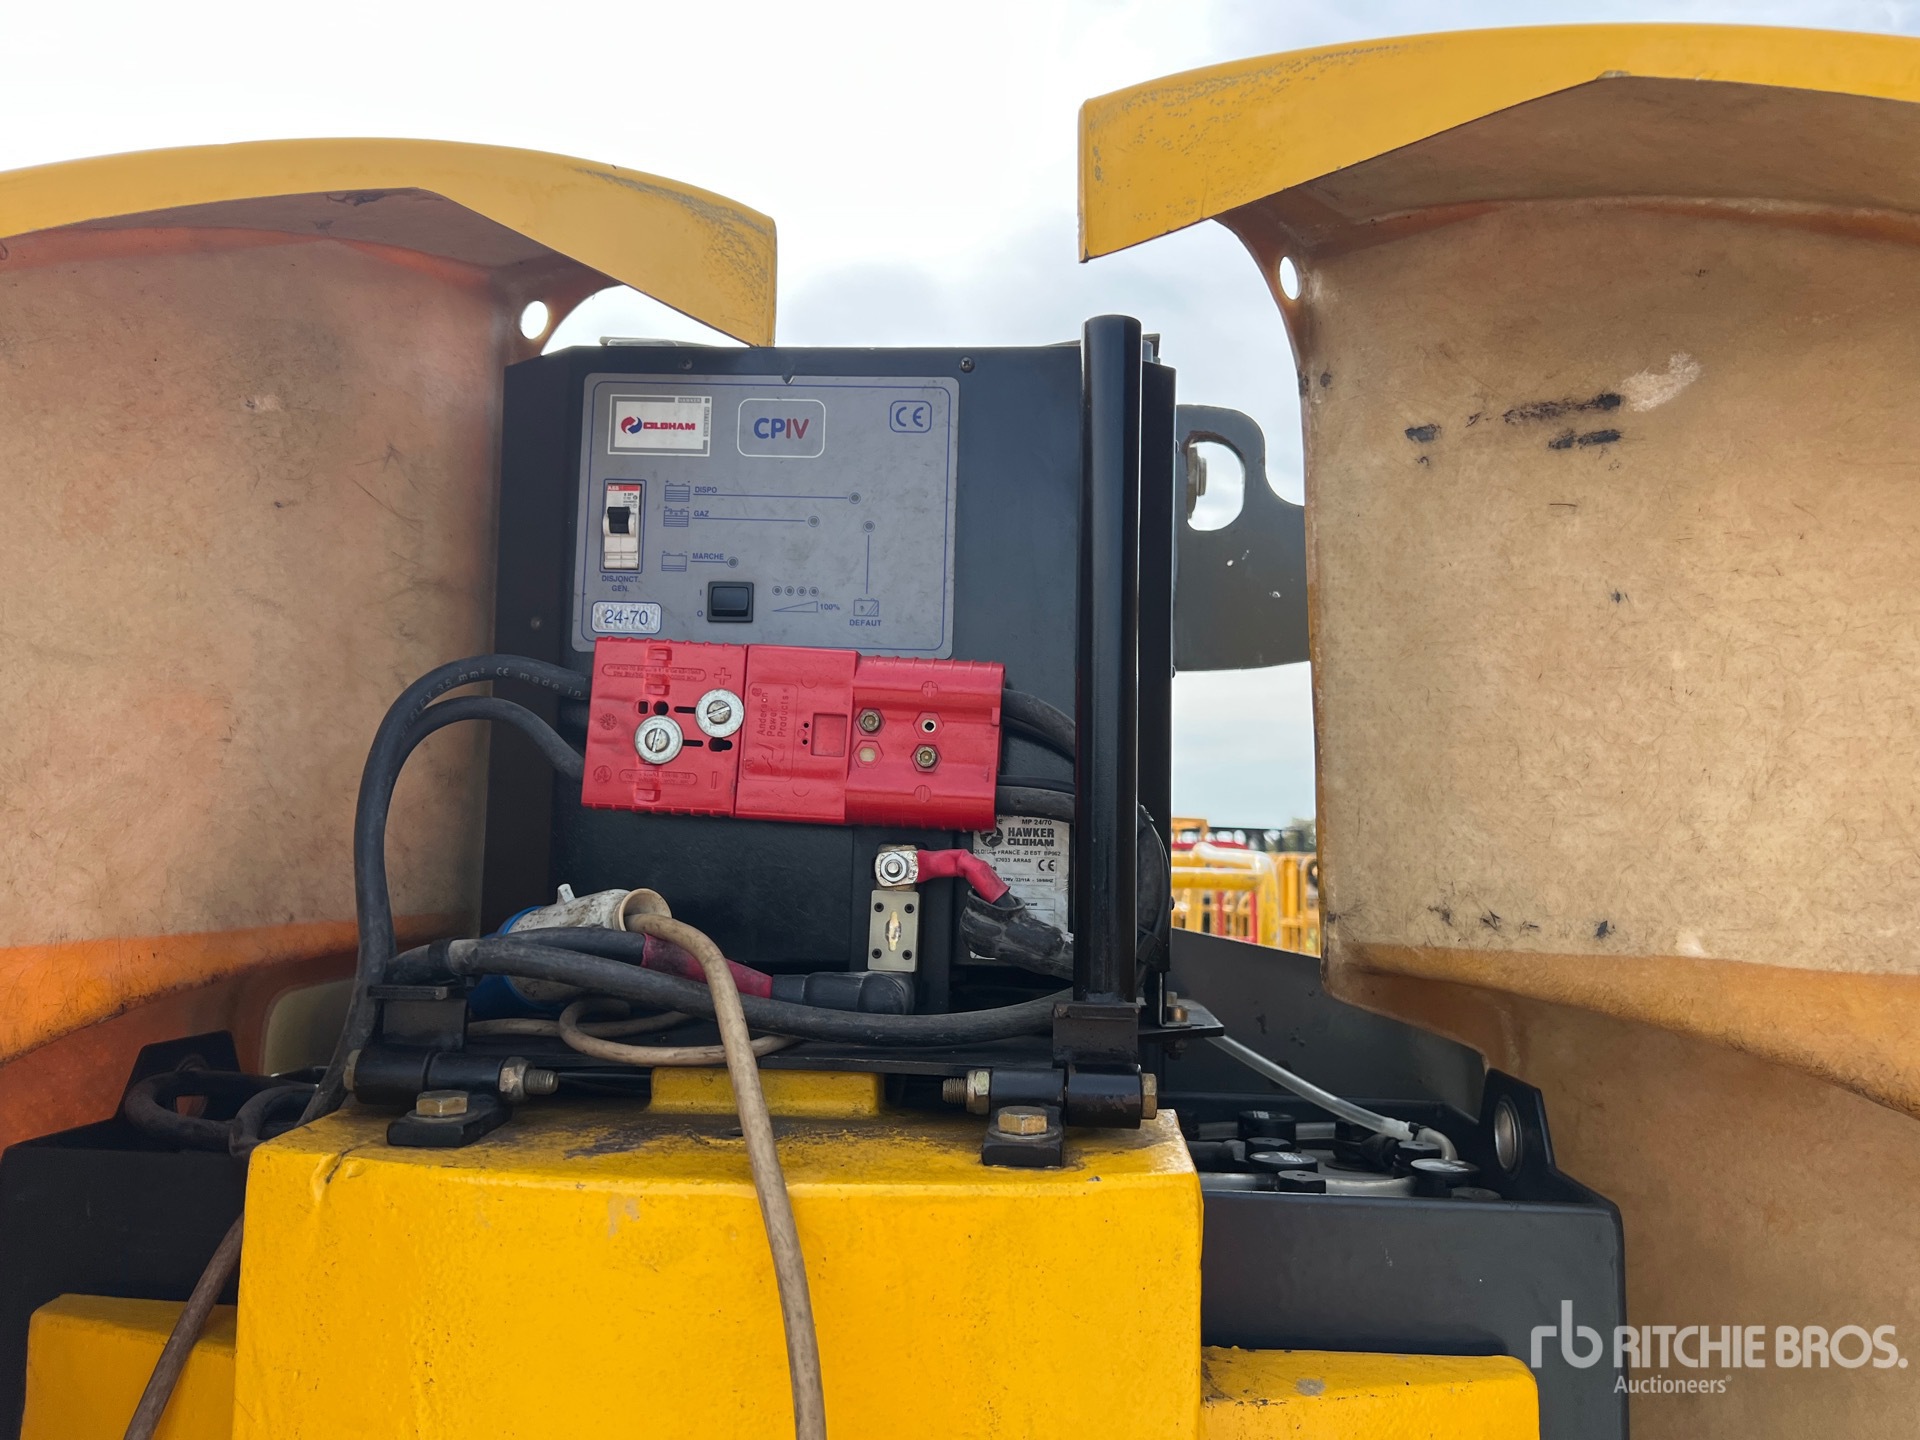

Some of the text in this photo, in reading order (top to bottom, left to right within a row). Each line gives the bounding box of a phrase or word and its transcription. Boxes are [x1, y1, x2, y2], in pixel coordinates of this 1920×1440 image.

[643, 421, 696, 431] OLDHAM
[753, 417, 810, 440] CPIV
[694, 486, 718, 494] DISPO
[693, 510, 710, 518] GAZ
[692, 552, 725, 560] MARCHE
[820, 603, 841, 611] 100%
[604, 608, 649, 626] 24-70
[849, 619, 882, 627] DEFAUT
[756, 692, 769, 736] Anderson
[776, 695, 790, 738] Products
[766, 707, 778, 737] Power
[1007, 827, 1055, 838] HAWKER
[1007, 838, 1055, 847] OLDHAM
